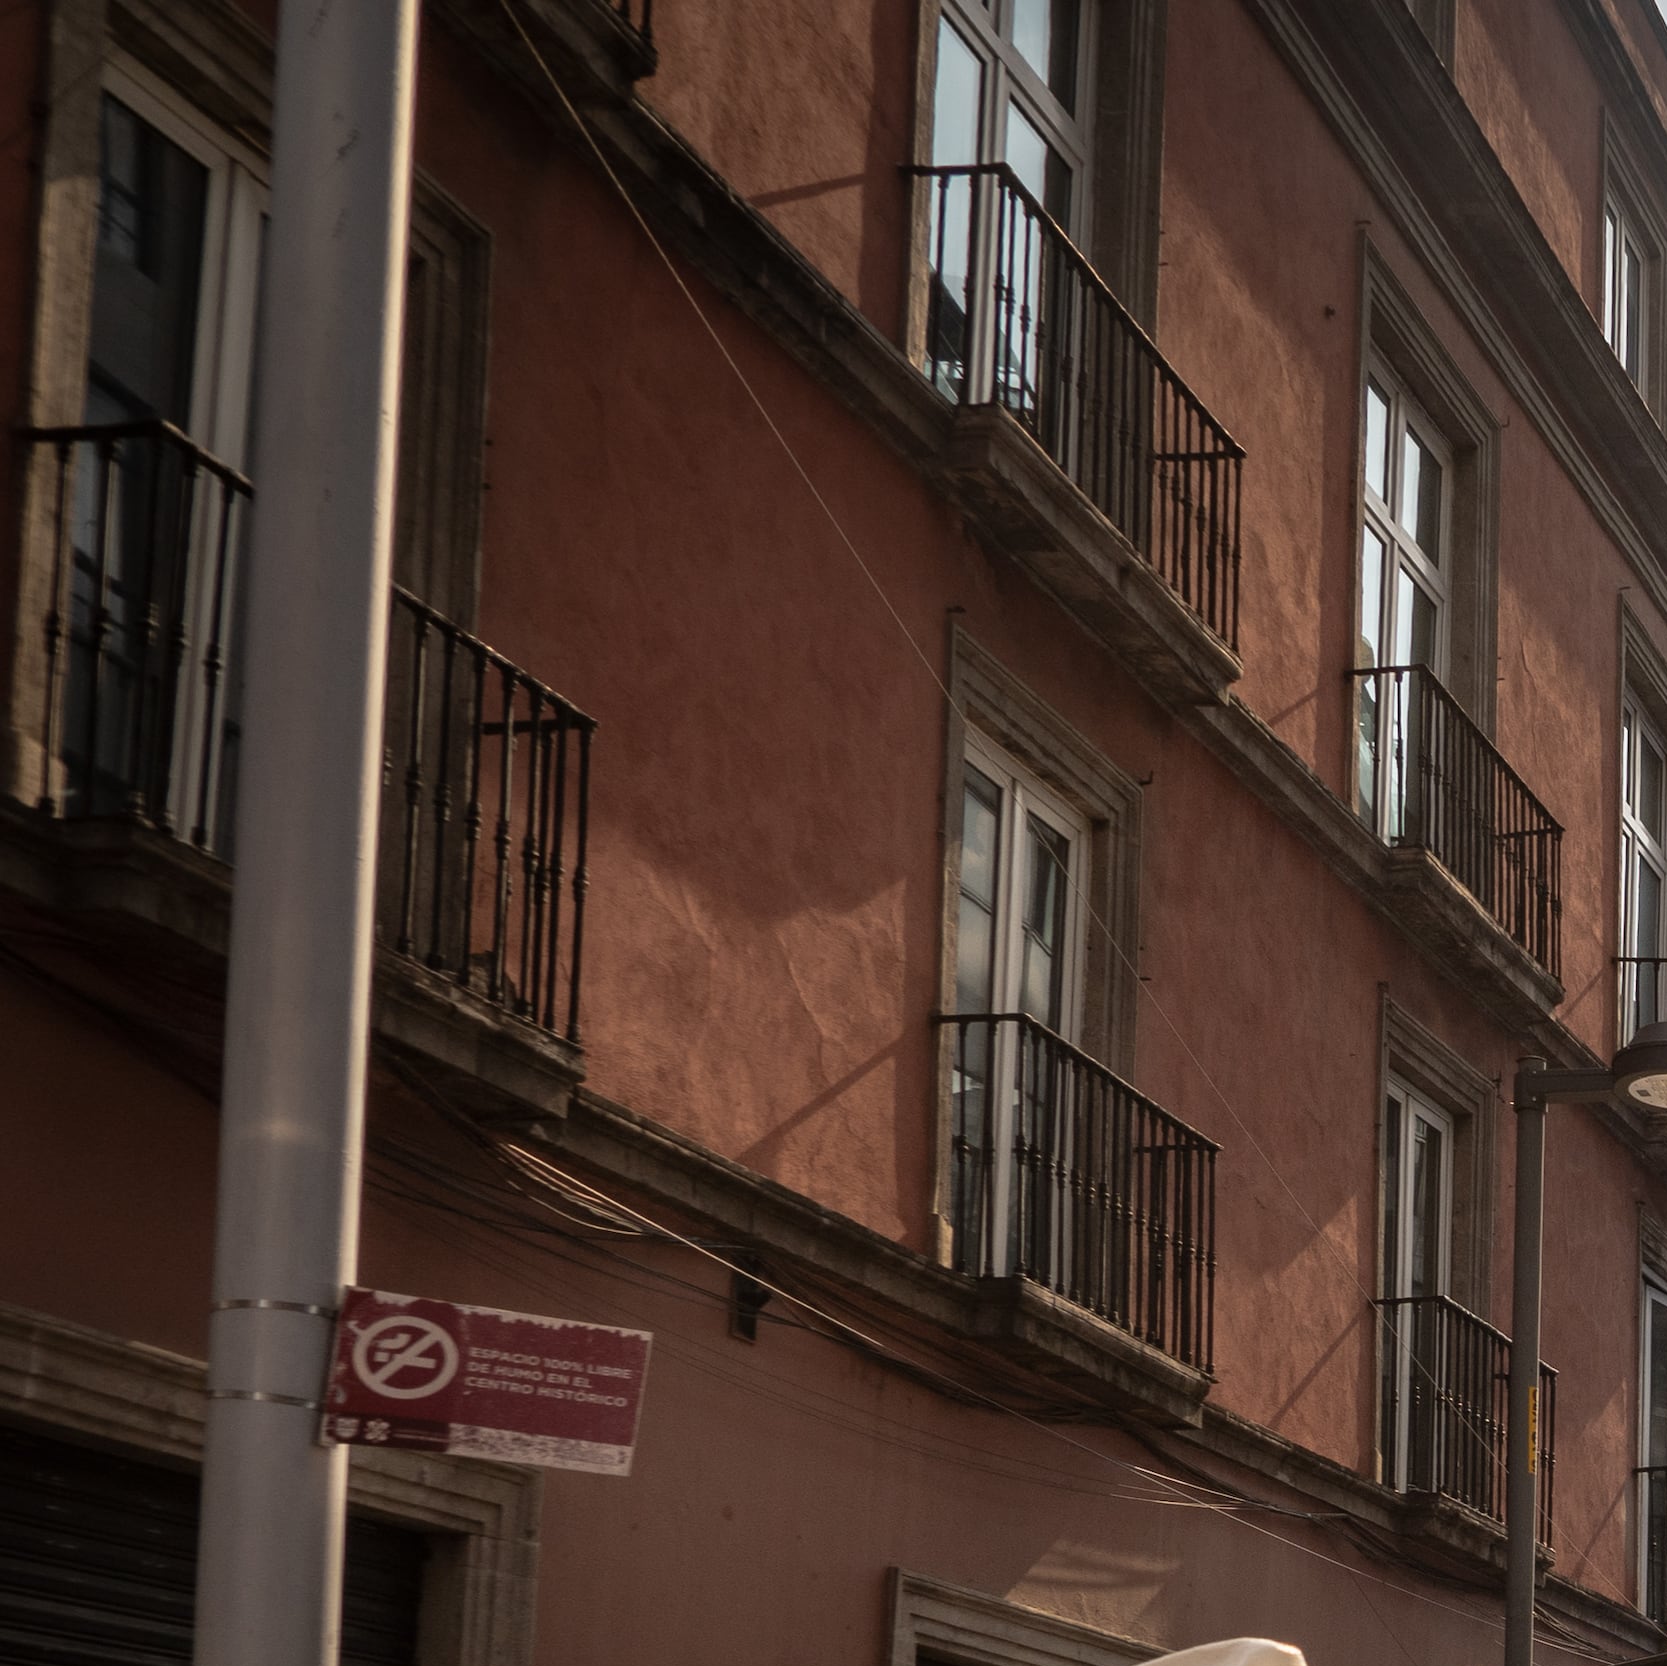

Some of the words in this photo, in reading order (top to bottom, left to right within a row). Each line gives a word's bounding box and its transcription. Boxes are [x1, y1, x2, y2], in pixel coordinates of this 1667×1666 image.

[465, 1361, 492, 1375] DE
[493, 1365, 545, 1382] HUMO
[546, 1372, 570, 1385] EN
[571, 1376, 593, 1389] EL
[468, 1346, 541, 1366] ESPACIO
[543, 1357, 585, 1373] 100%
[586, 1363, 633, 1380] LIBRE
[463, 1376, 535, 1394] CENTRO
[535, 1384, 628, 1407] HISTÓRICO
